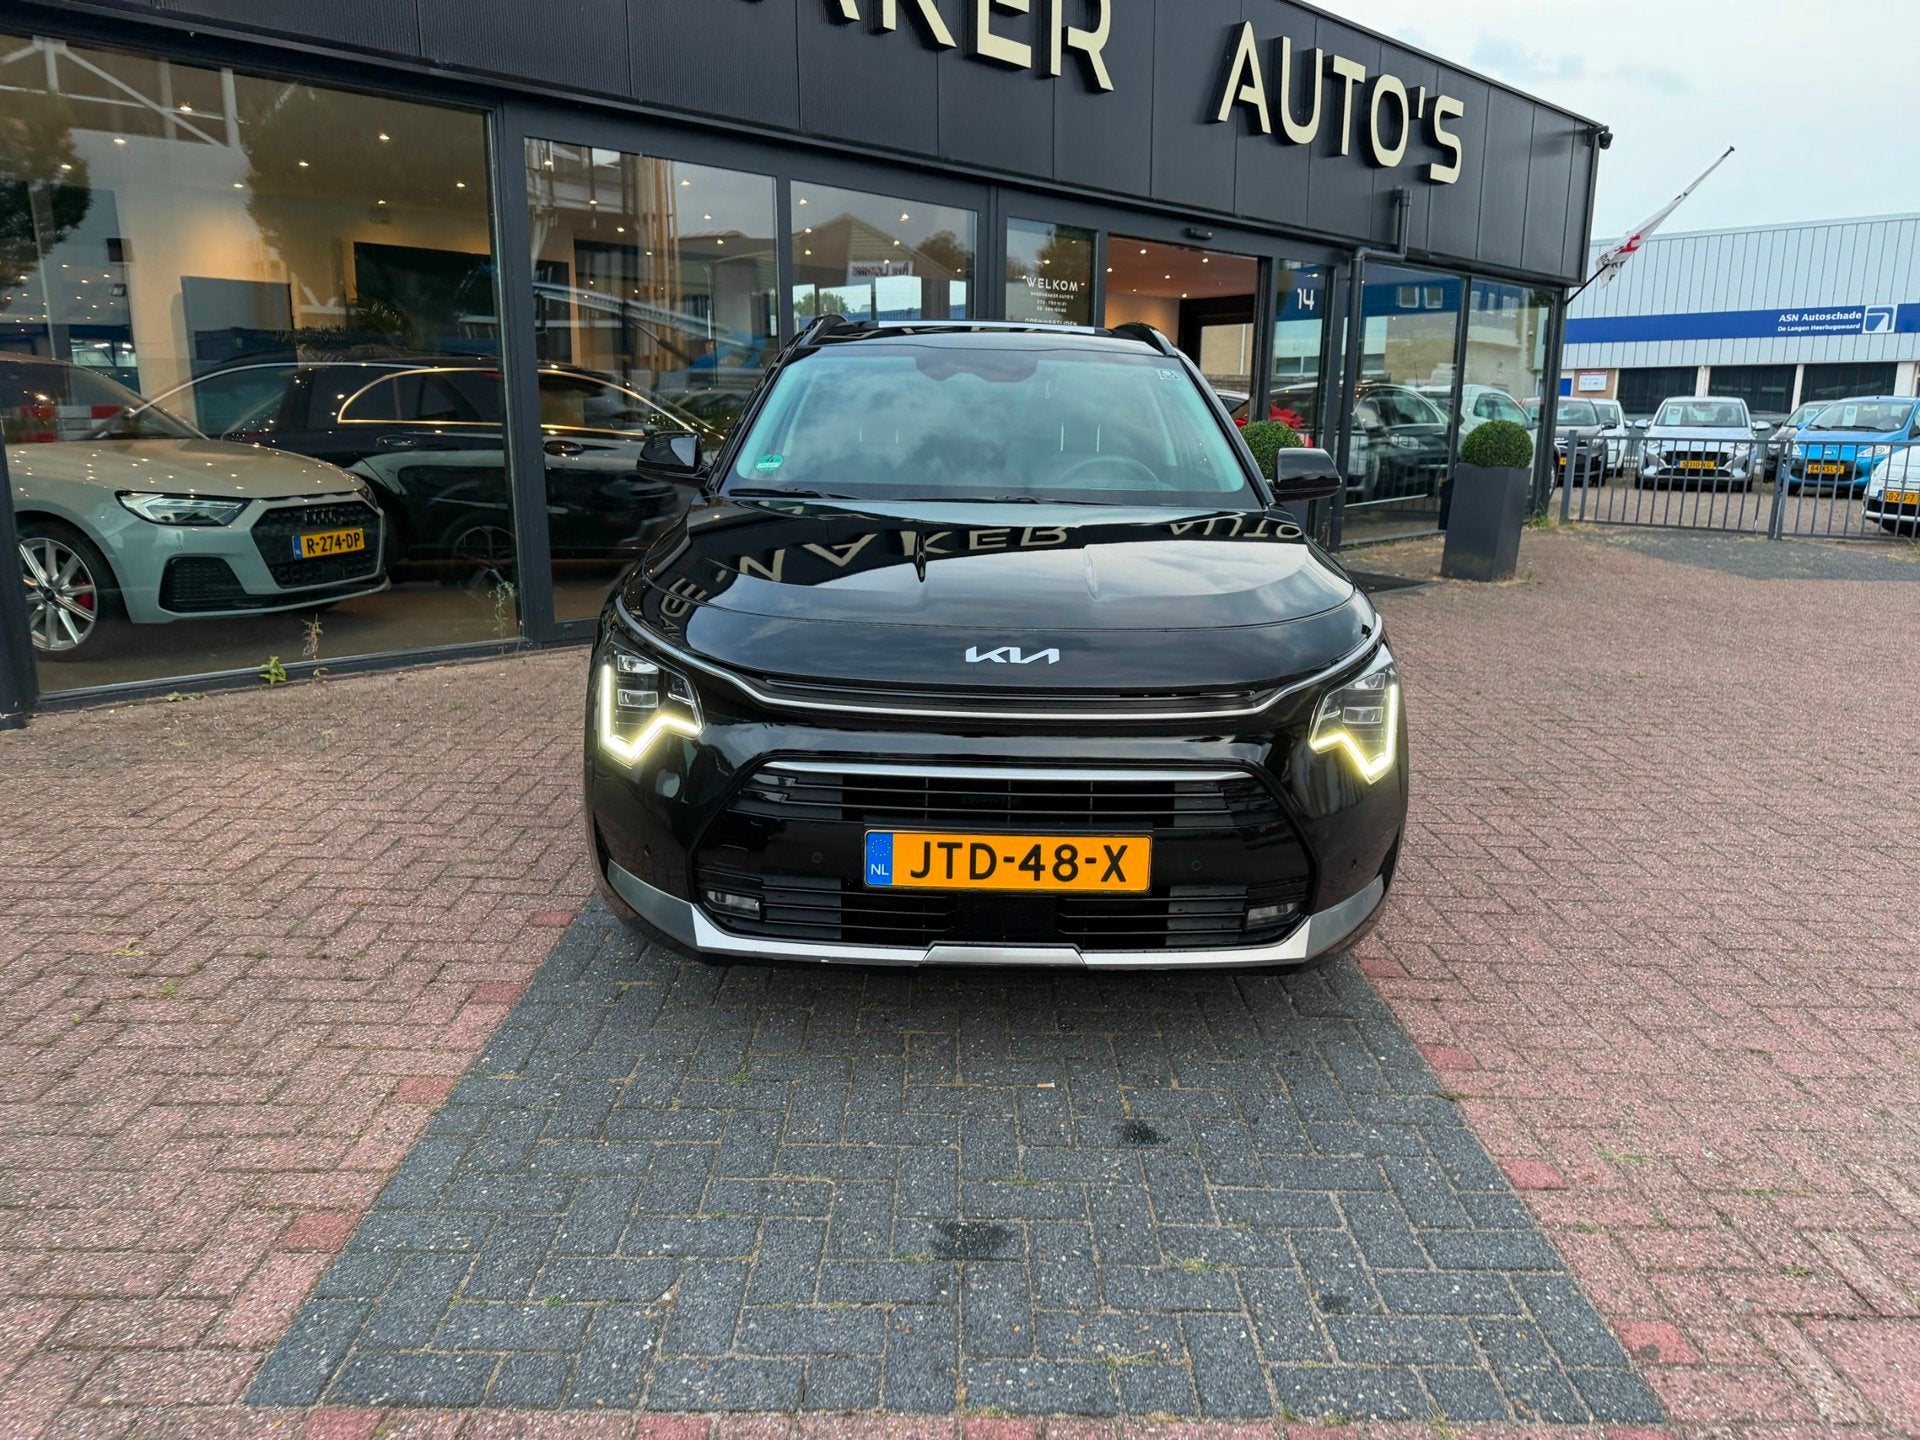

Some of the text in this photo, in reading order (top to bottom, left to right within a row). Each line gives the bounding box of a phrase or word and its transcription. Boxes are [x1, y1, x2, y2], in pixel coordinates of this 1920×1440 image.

[838, 0, 1464, 184] ER AUTO'S
[1026, 277, 1078, 292] WELKOM
[1297, 287, 1315, 310] 14
[1778, 311, 1862, 322] ASN Autoschade
[306, 532, 361, 554] R-274-DP
[870, 841, 1128, 883] NL JTD-48-X
